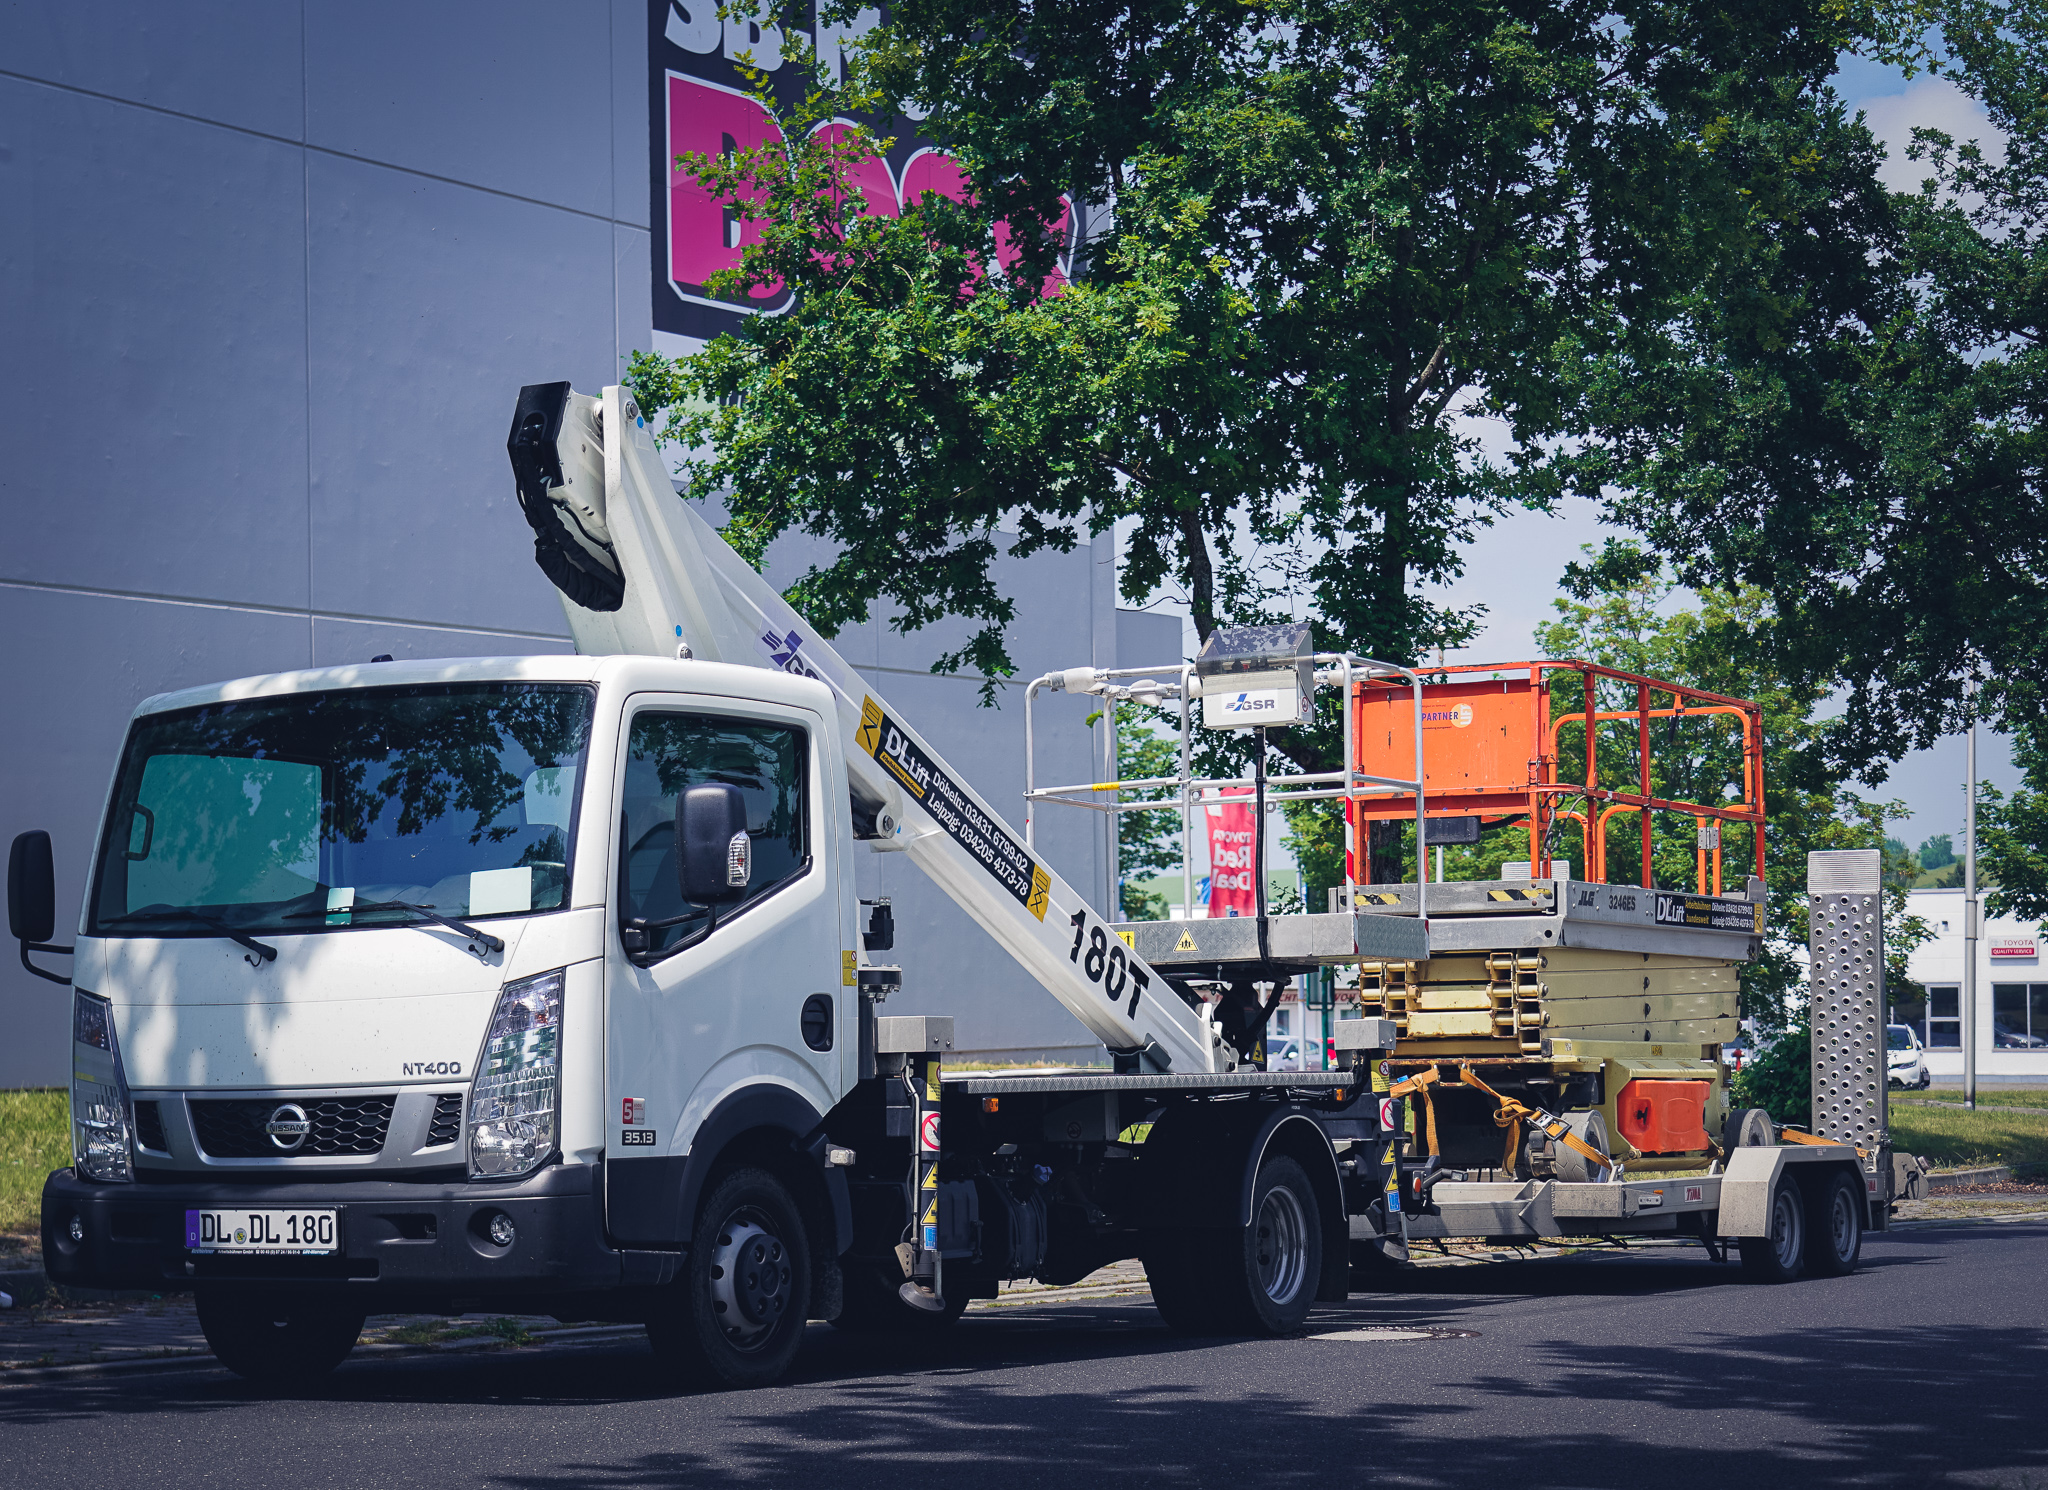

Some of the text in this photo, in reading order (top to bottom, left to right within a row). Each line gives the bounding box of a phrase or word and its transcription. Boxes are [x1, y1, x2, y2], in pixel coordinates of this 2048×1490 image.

[1242, 699, 1275, 711] GSR
[1422, 711, 1459, 721] PARTNER
[932, 771, 1029, 874] Döbeln: 03431 6799-02
[927, 792, 1029, 896] Leipzig: 034205 4173-78
[1578, 890, 1636, 911] JLG 3246ES
[1070, 908, 1150, 1021] 180T
[402, 1061, 462, 1076] NT400
[623, 1102, 633, 1120] 5
[268, 1122, 306, 1132] NISSAN
[624, 1132, 654, 1144] 35.13
[190, 1232, 196, 1241] D
[201, 1213, 232, 1243] DL
[286, 1214, 333, 1244] 180
